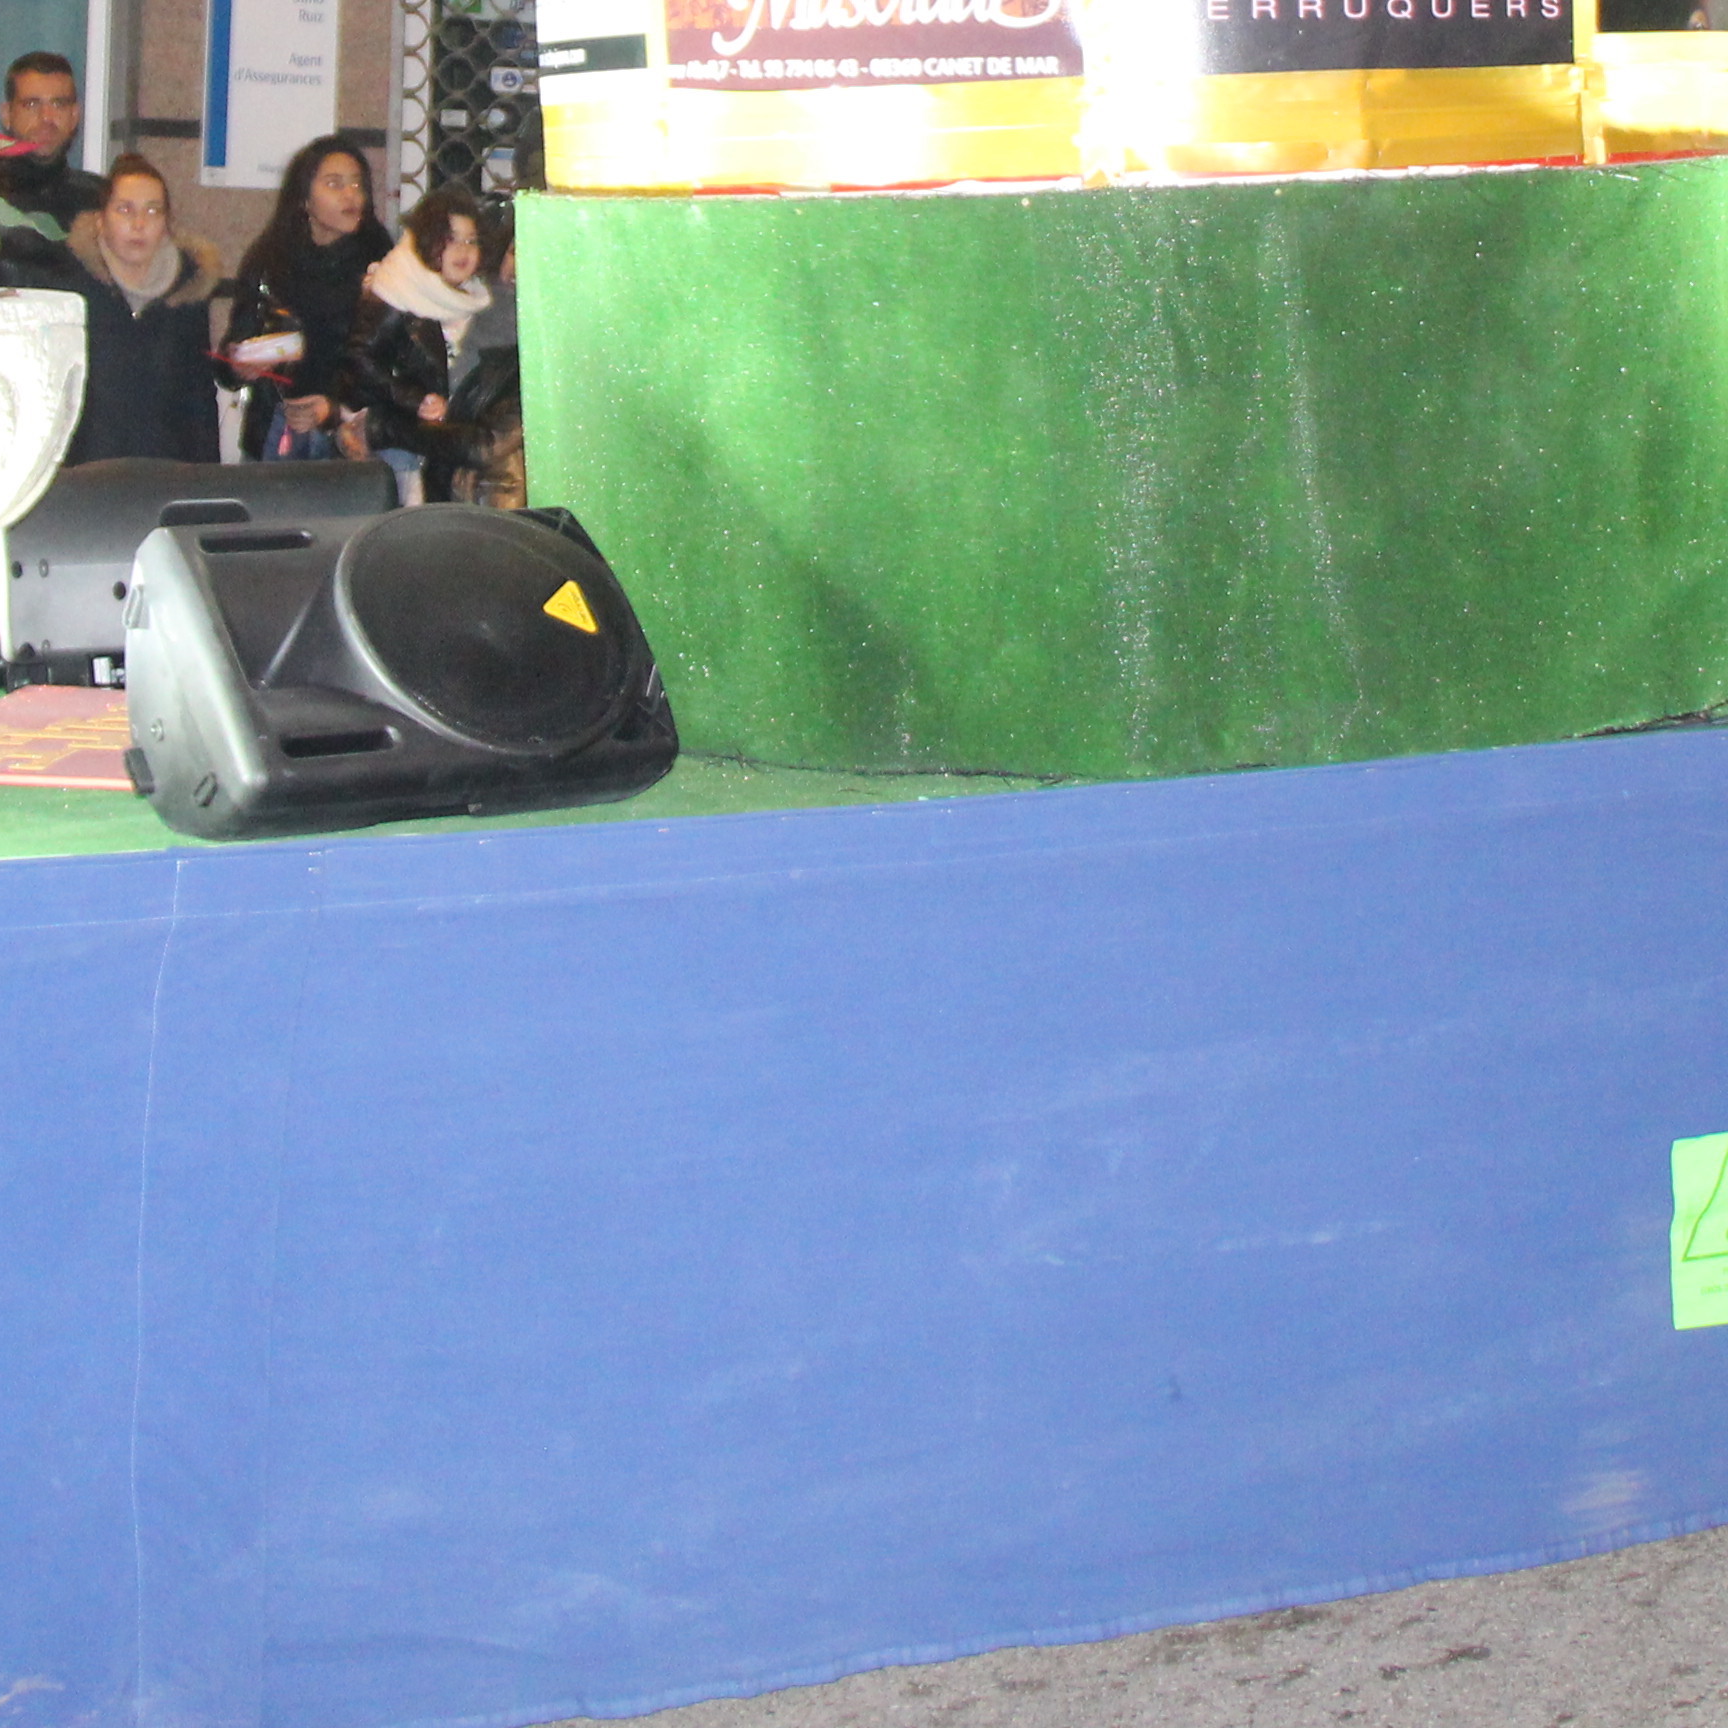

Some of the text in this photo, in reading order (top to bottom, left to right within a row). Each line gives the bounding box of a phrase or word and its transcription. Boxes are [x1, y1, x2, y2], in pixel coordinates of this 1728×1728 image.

[297, 8, 324, 23] Ruiz
[288, 52, 323, 69] Agent
[923, 56, 1060, 77] CANET DE MAR
